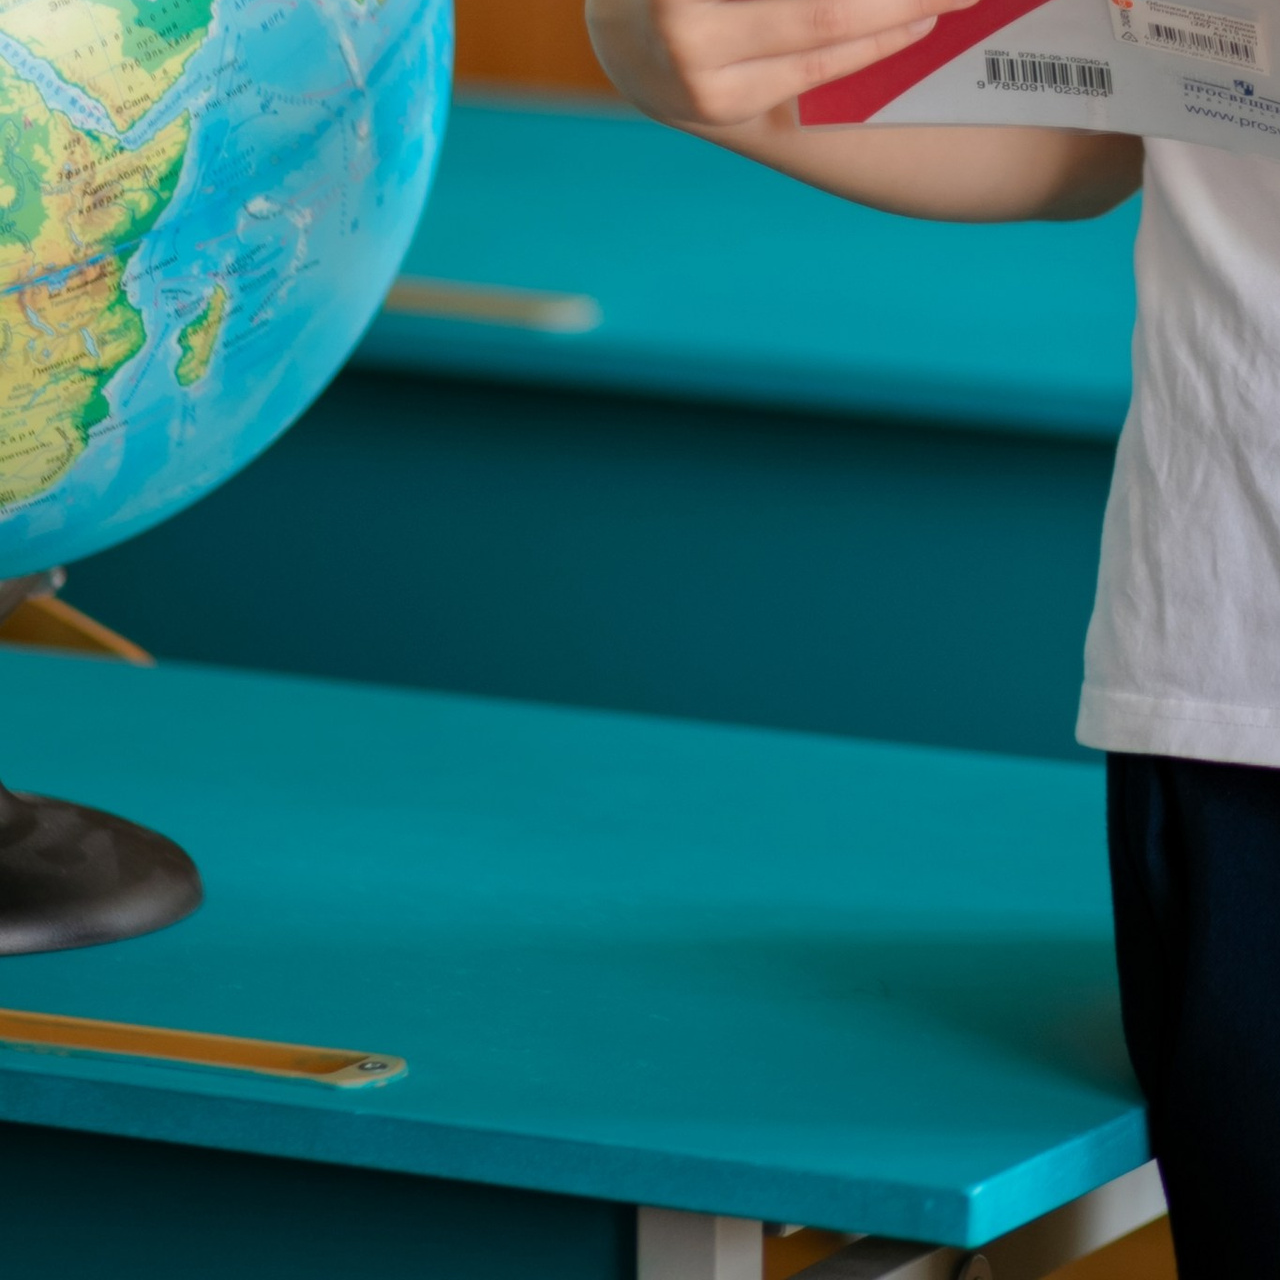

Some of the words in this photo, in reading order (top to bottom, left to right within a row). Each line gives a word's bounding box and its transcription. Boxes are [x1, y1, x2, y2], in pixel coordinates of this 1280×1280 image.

[984, 49, 1010, 57] ISBN
[1018, 51, 1110, 67] 978-5-09-102340-4
[976, 80, 986, 89] 9
[994, 80, 1046, 93] 785091
[1053, 84, 1109, 98] 023404
[123, 93, 151, 111] Сана
